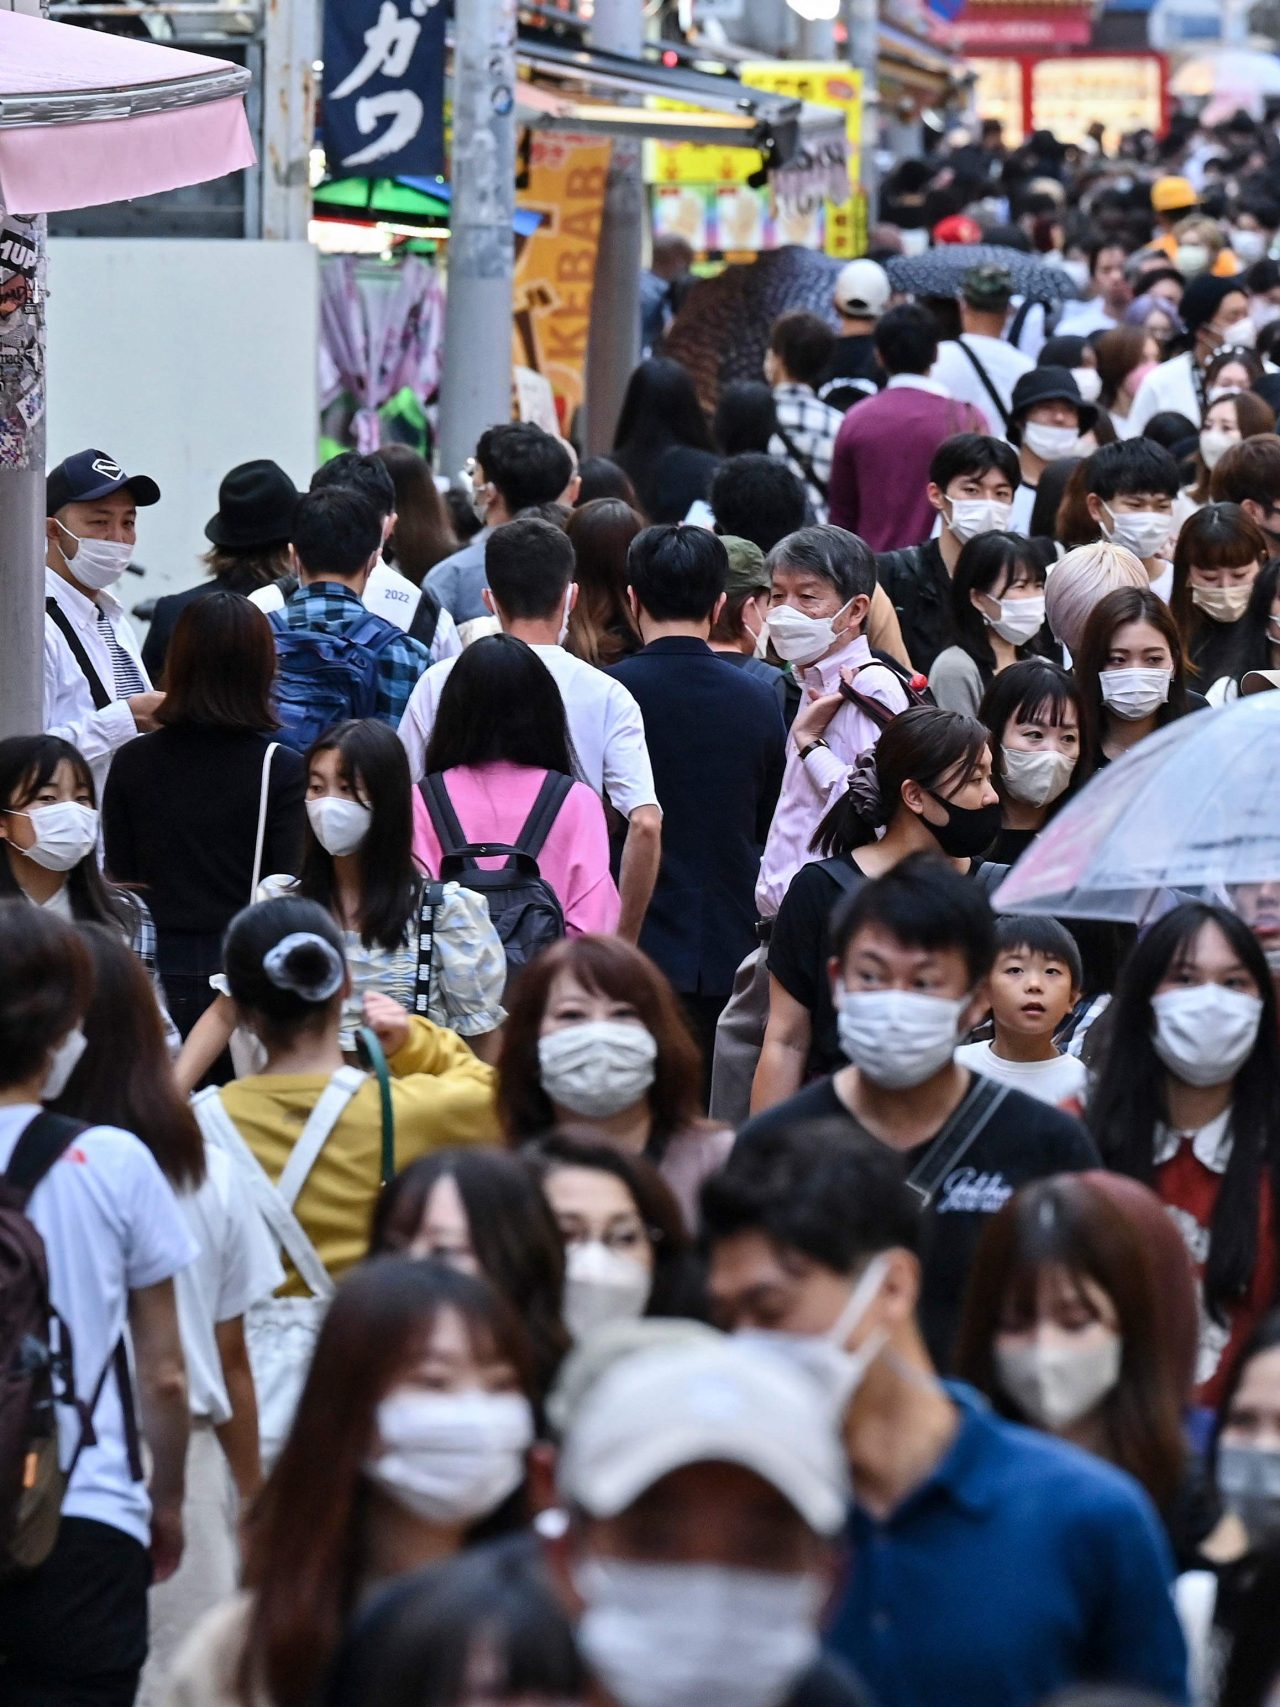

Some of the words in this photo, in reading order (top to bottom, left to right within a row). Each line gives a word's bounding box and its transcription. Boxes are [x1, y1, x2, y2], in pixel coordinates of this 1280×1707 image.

[0, 239, 37, 269] 1UP
[545, 165, 605, 360] KEBAB
[385, 589, 409, 603] 2022
